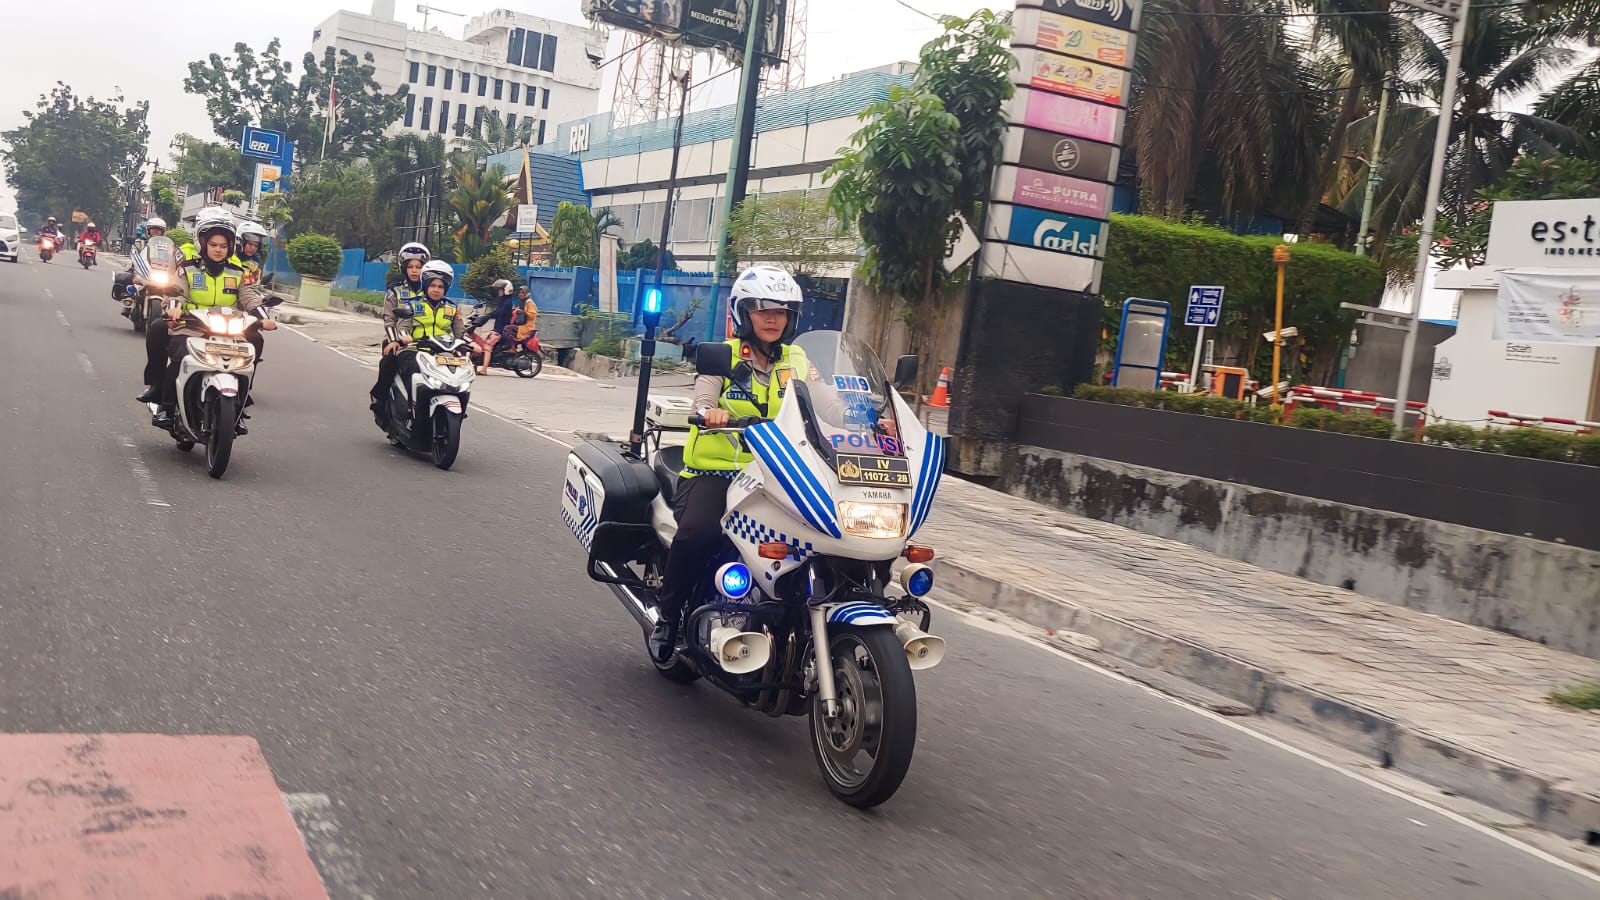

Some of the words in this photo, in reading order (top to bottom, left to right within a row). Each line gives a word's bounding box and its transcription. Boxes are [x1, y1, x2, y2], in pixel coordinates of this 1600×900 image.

[691, 10, 726, 26] MEROKOK
[569, 122, 590, 153] RRI
[250, 140, 271, 152] RRI
[1053, 186, 1097, 202] PUTRA
[835, 376, 869, 391] BM9
[830, 433, 905, 456] POLISI
[877, 459, 890, 470] IV
[863, 471, 890, 482] 11072
[862, 490, 892, 500] YAMAHA
